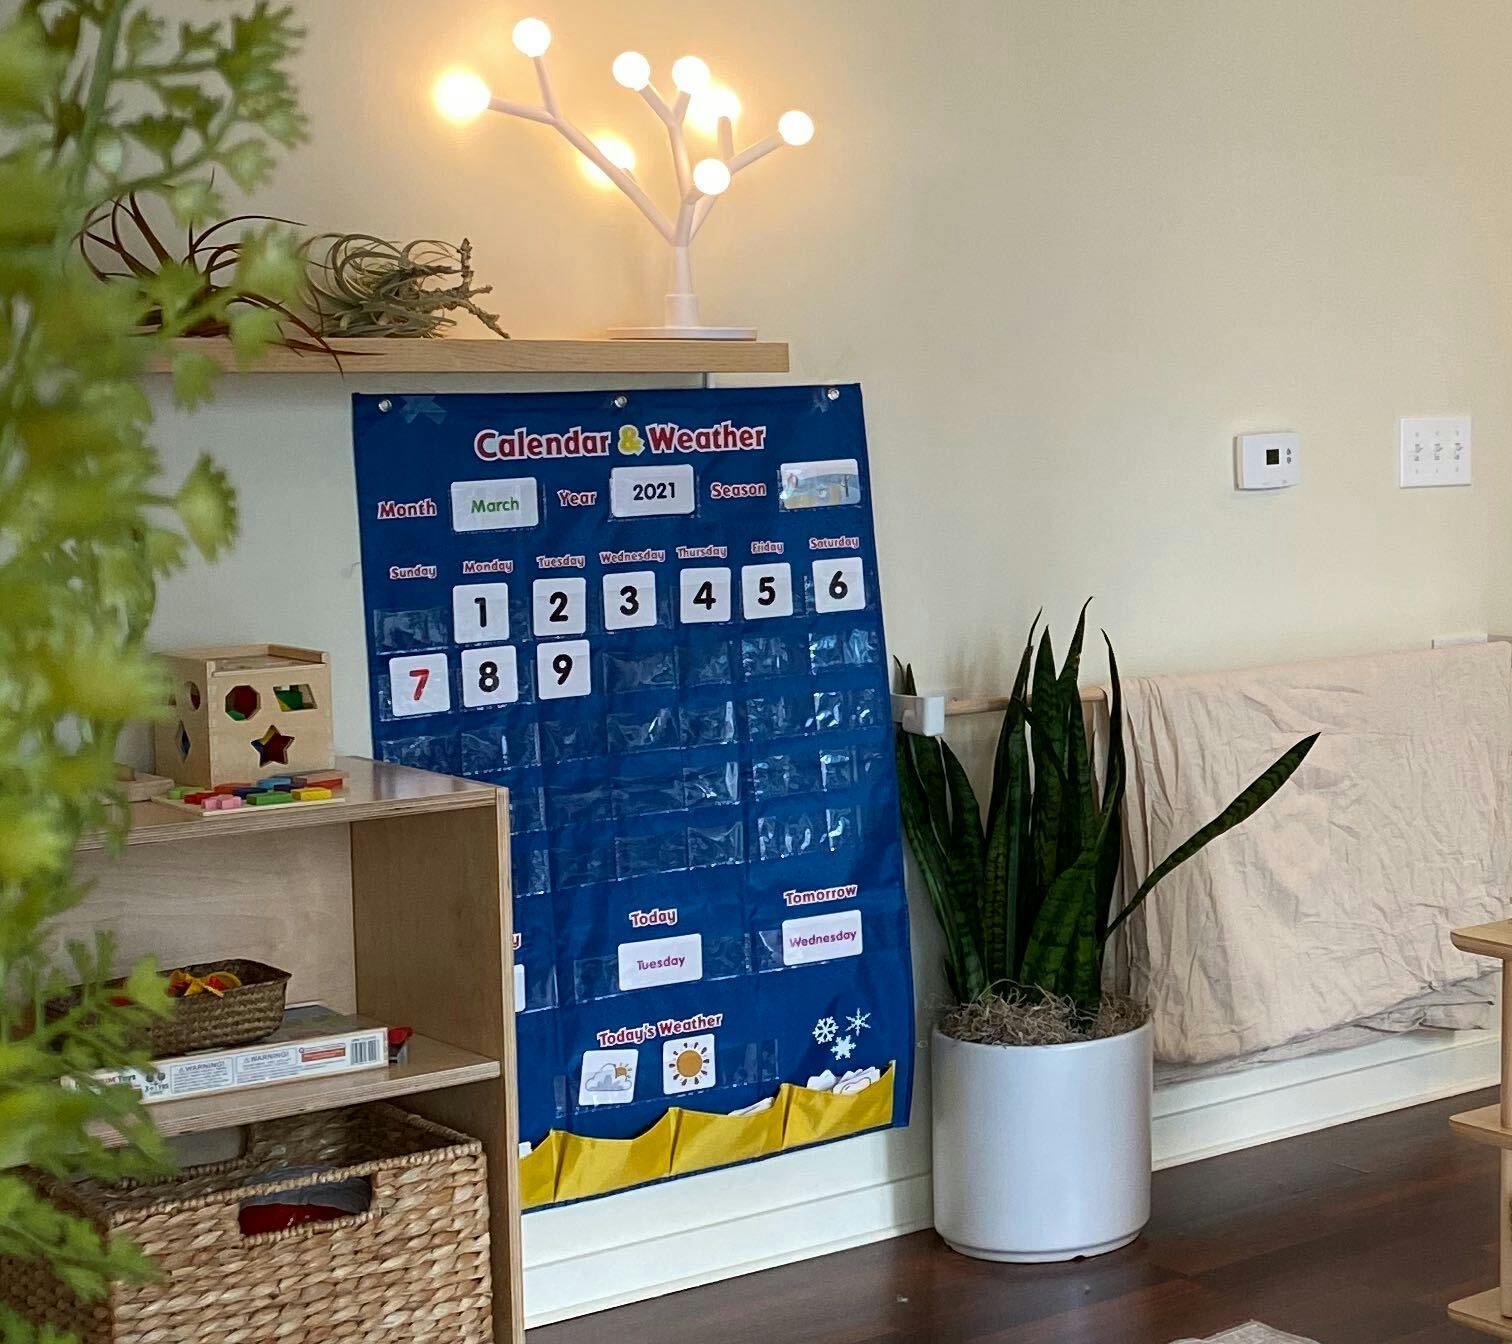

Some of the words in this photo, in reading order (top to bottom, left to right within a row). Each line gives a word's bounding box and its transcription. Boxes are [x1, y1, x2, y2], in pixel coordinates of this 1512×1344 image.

[474, 425, 611, 461] Calendar
[618, 424, 645, 455] &
[646, 420, 766, 454] Weather
[377, 498, 438, 519] Month
[471, 497, 520, 514] March
[557, 489, 597, 507] Year
[632, 482, 676, 501] 2021
[711, 482, 767, 499] Season
[390, 564, 437, 580] Sunday
[463, 559, 514, 574] Monday
[536, 554, 586, 568] Tuesday
[600, 549, 666, 564] Wednesday
[676, 545, 728, 559] Thursday
[751, 540, 784, 554] Friday
[809, 536, 860, 550] Saturday
[474, 597, 487, 628] 1
[549, 591, 569, 622] 2
[619, 585, 639, 616] 3
[693, 580, 716, 611] 4
[757, 576, 776, 606] 5
[829, 570, 848, 600] 6
[409, 669, 430, 701] 7
[478, 661, 500, 693] 8
[552, 654, 573, 685] 9
[783, 884, 858, 906] Tomorrow
[629, 908, 678, 928] Today
[789, 929, 857, 948] Wednesday
[637, 956, 686, 971] Tuesday
[598, 1023, 656, 1047] Today's
[656, 1013, 723, 1037] Weather
